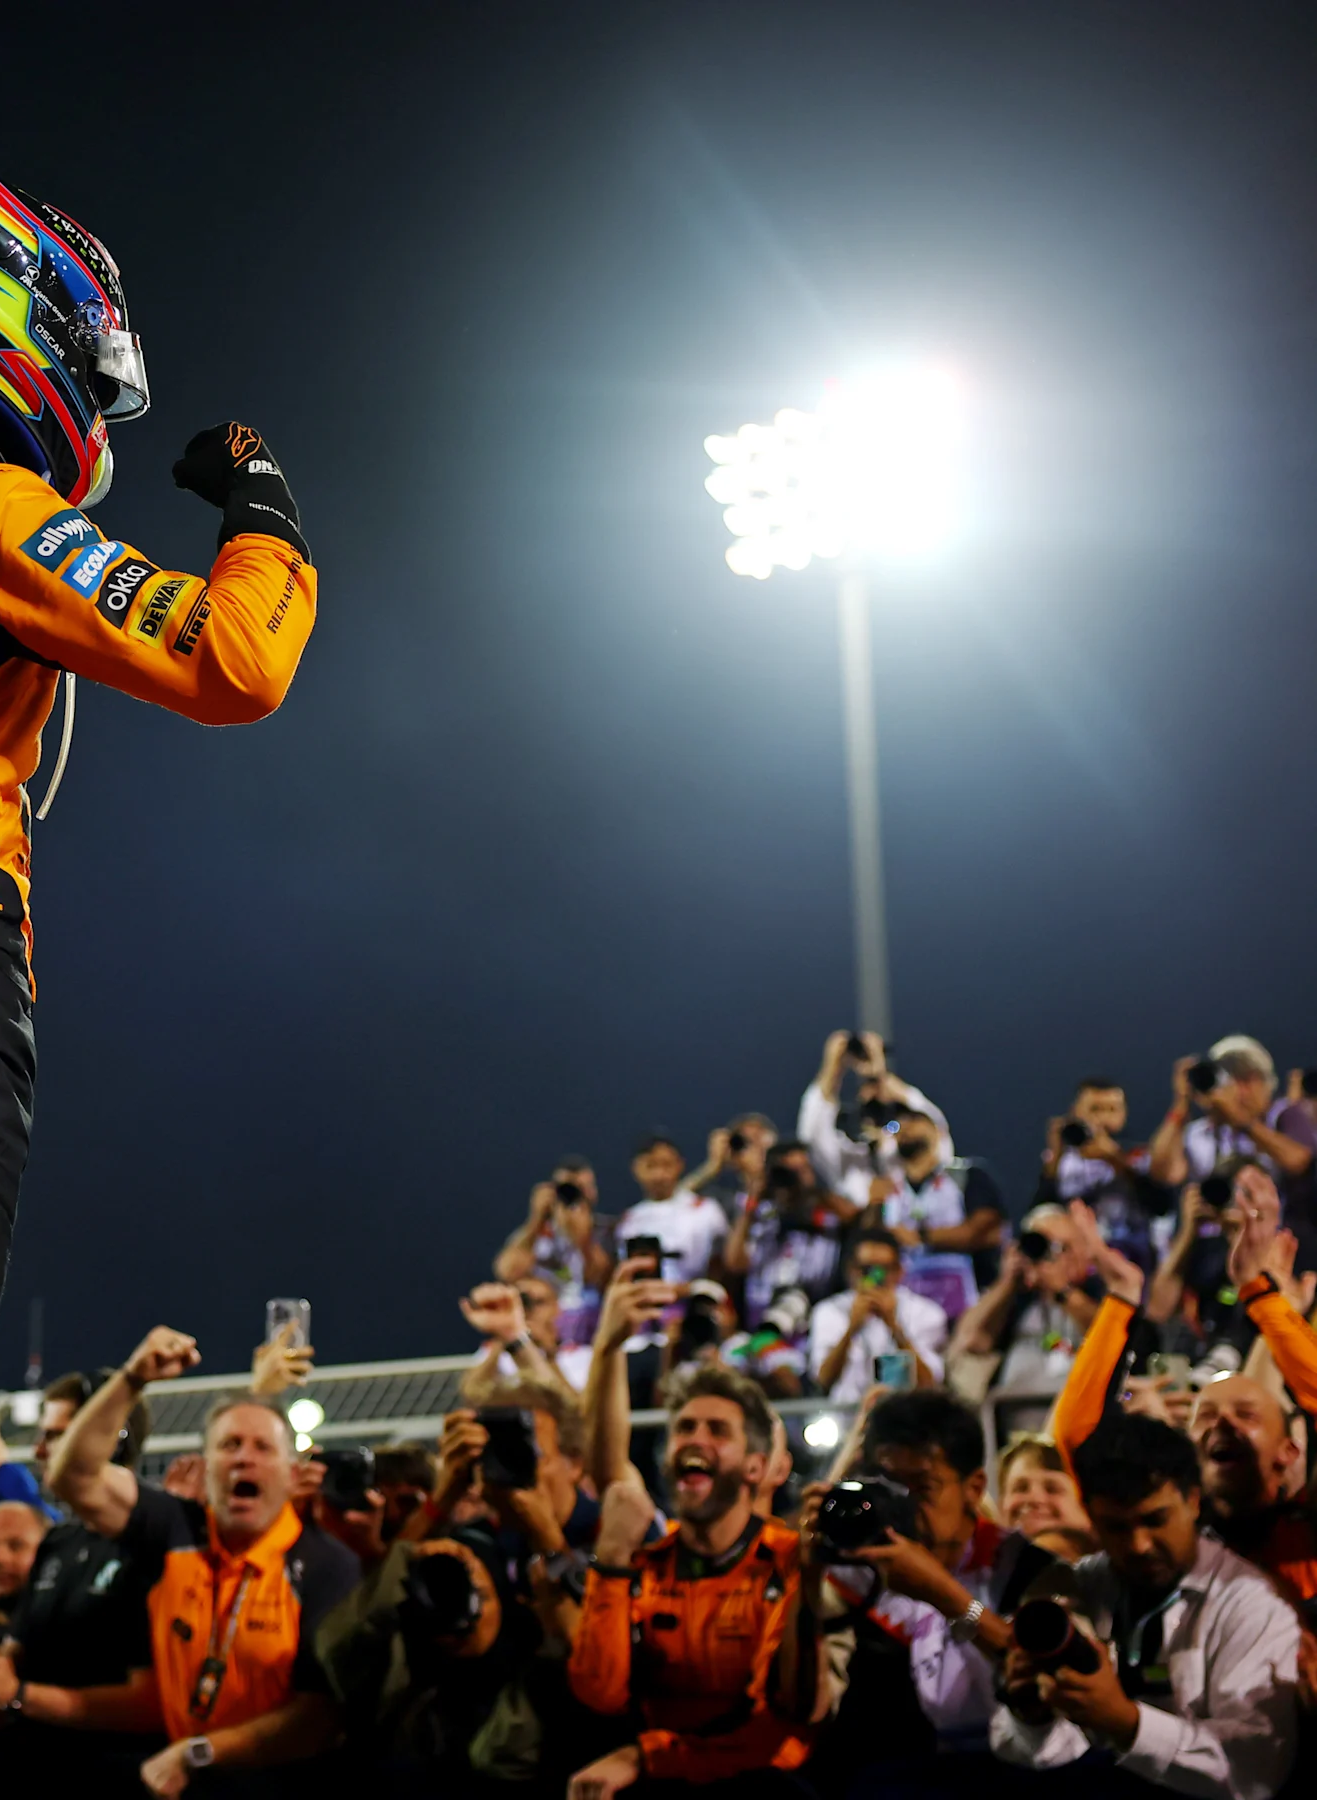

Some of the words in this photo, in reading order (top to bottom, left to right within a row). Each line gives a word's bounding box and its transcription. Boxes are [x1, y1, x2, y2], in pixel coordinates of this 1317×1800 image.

[54, 223, 114, 294] ENERGY
[31, 286, 53, 308] Aviation
[51, 304, 67, 323] Group
[35, 323, 65, 360] OSCAR
[248, 502, 287, 520] RICHARD
[37, 518, 93, 557] allwyn
[72, 541, 118, 589] ECOLAB
[106, 564, 150, 611] okta
[266, 573, 296, 635] RICHARD
